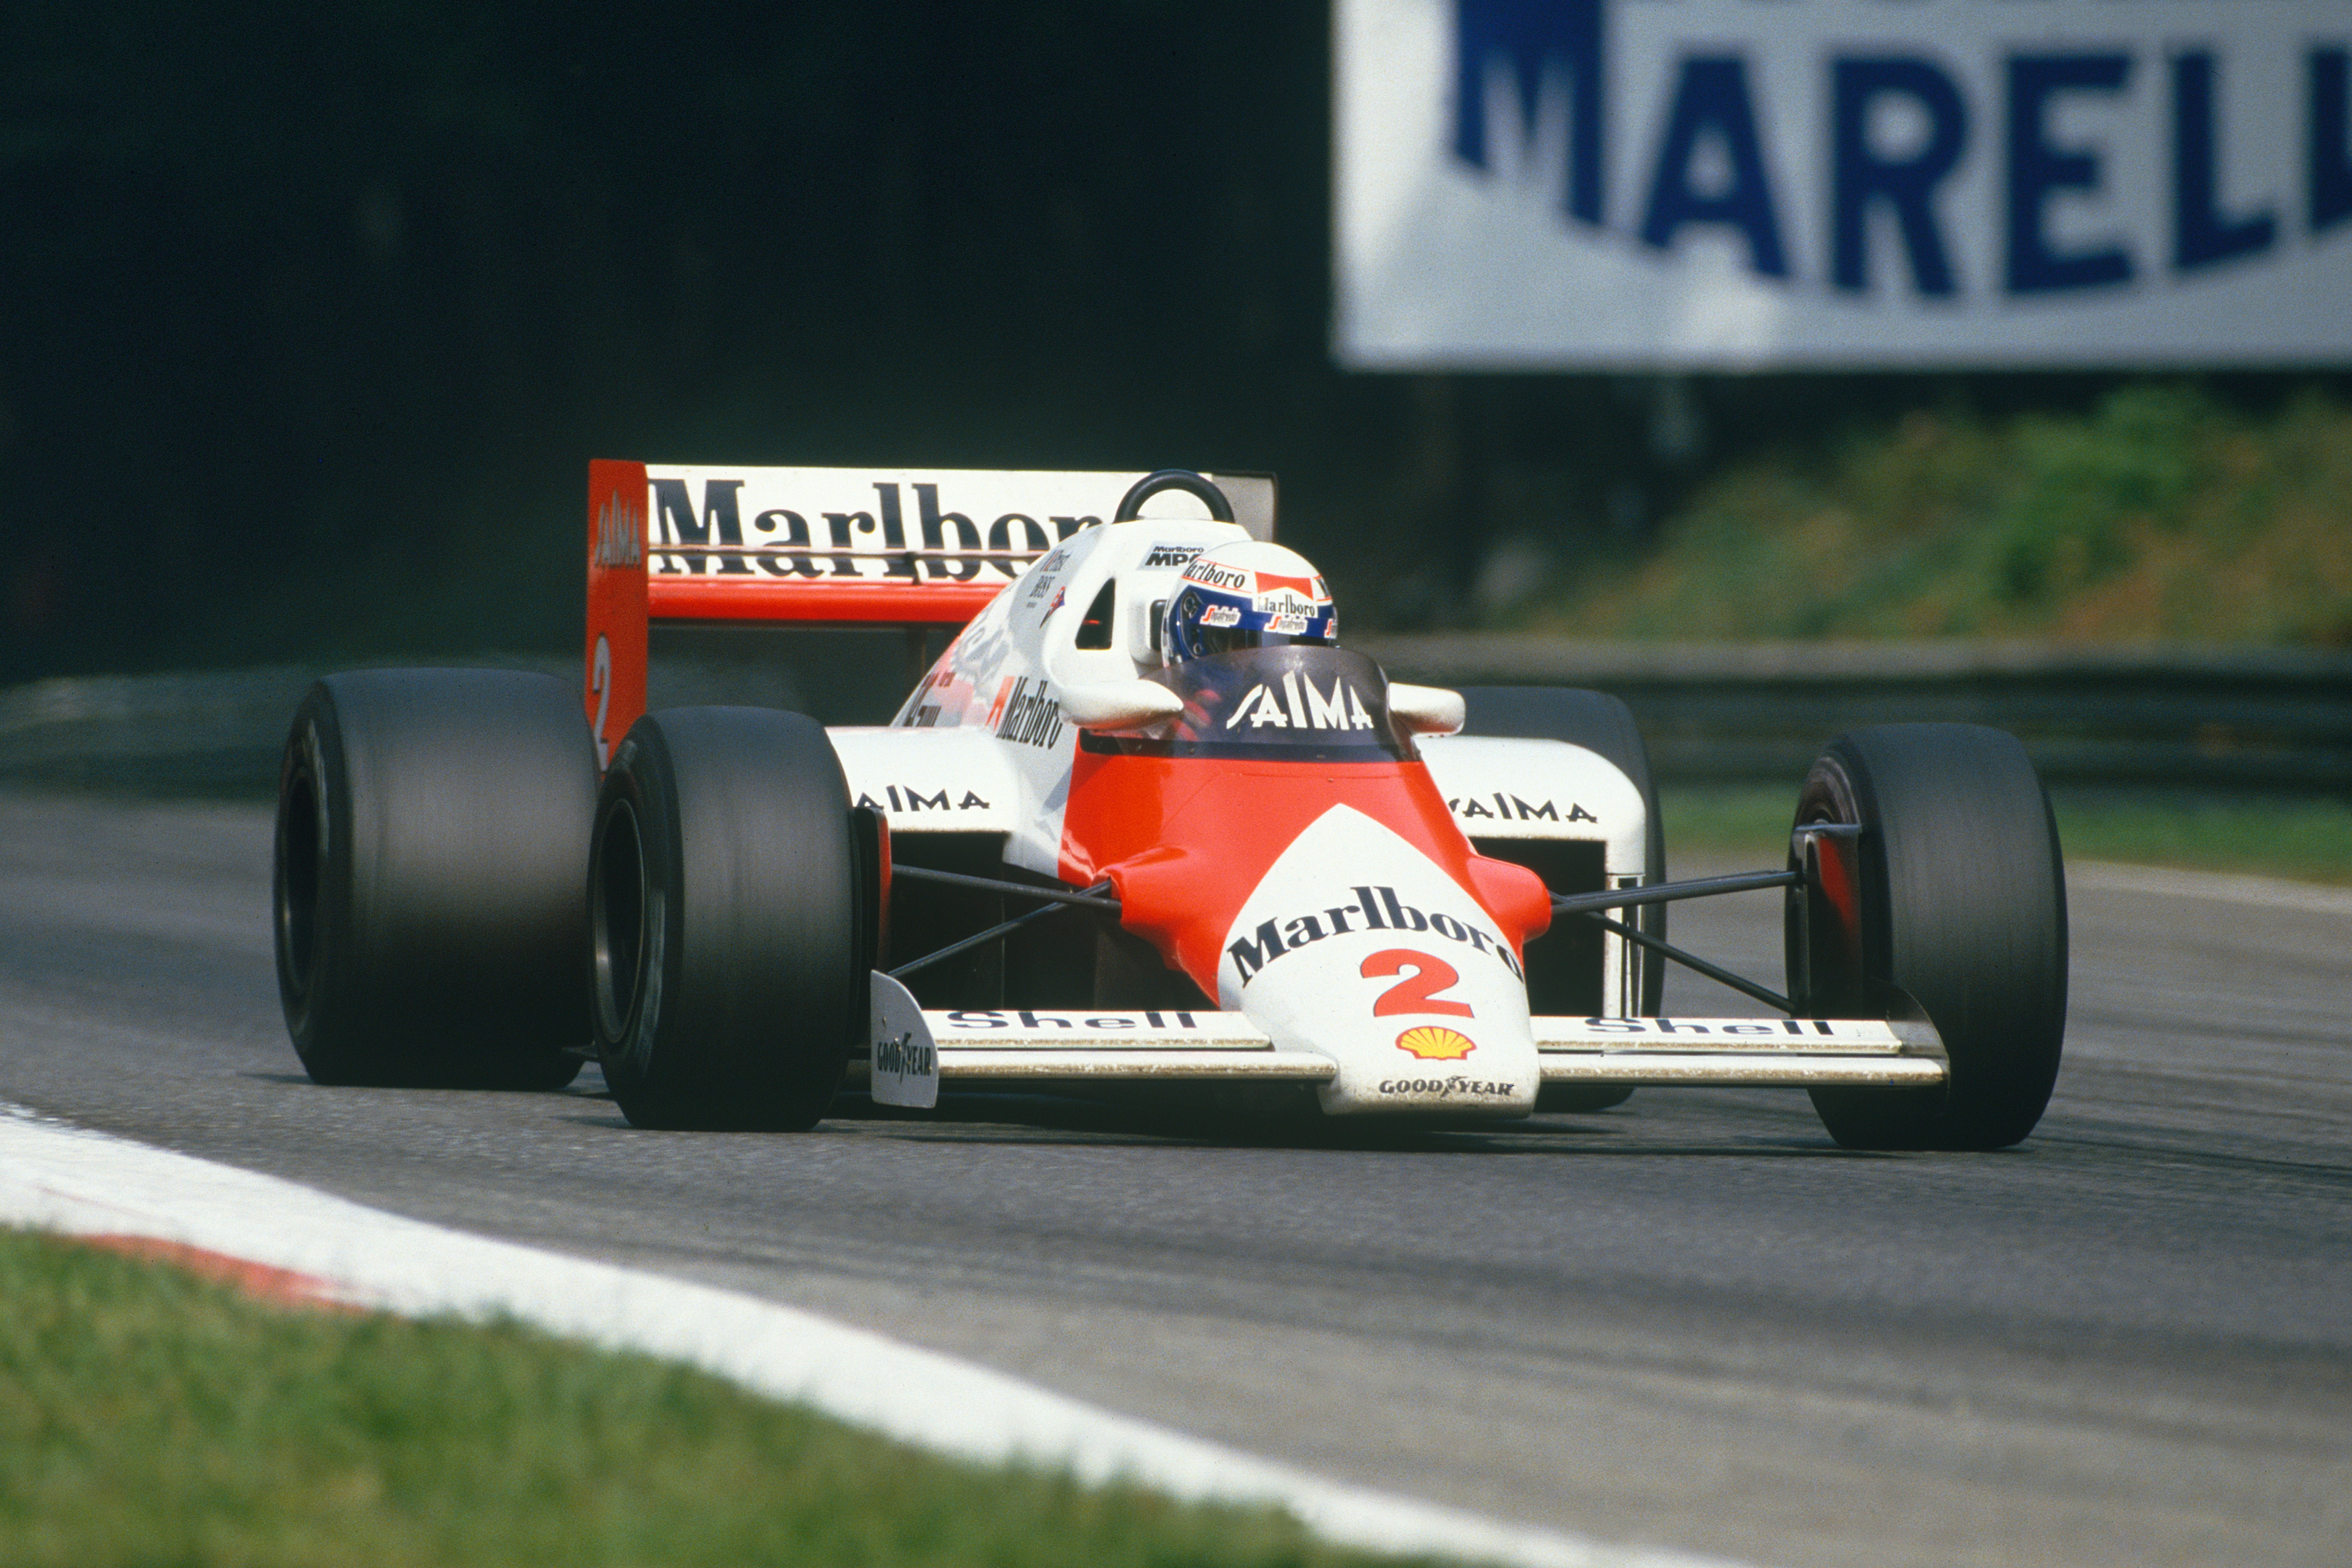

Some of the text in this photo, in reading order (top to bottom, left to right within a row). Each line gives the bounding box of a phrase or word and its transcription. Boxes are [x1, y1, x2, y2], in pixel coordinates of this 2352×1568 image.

[593, 632, 611, 772] 2
[856, 784, 990, 813] AIMA
[1226, 886, 1525, 989] Marlboro
[1360, 948, 1476, 1019] 2
[946, 1011, 1198, 1030] Shell
[1584, 1017, 1835, 1035] Shell
